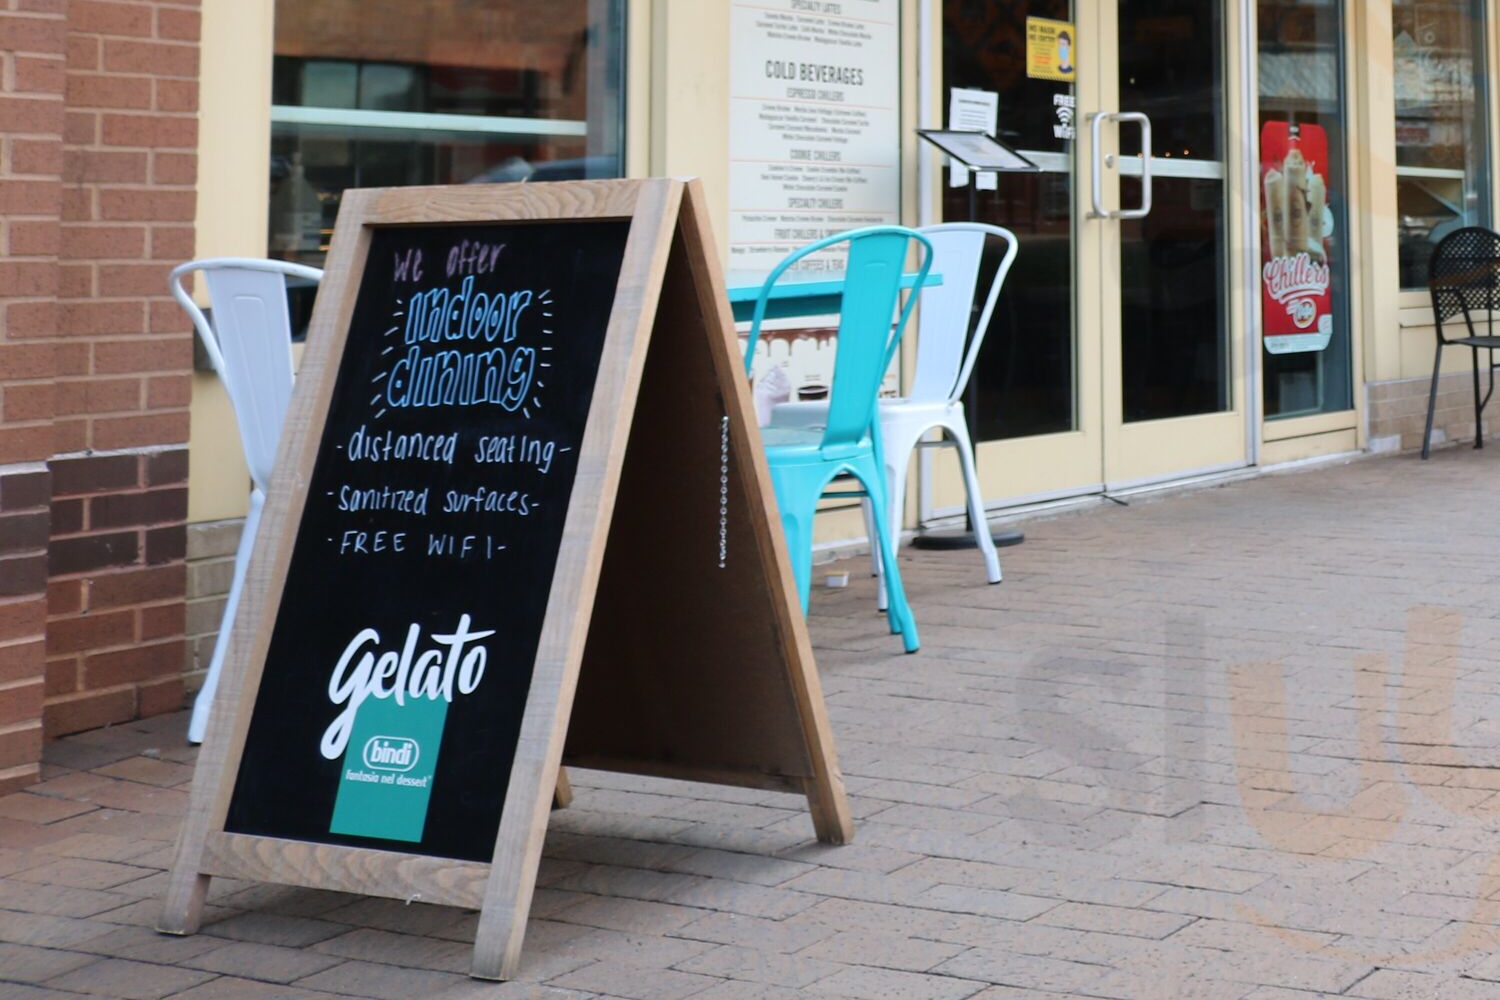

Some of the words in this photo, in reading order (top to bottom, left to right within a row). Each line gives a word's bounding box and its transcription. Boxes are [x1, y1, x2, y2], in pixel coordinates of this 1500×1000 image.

[765, 59, 796, 80] COLD
[799, 63, 864, 86] BEVERAGES
[446, 240, 507, 278] offer
[1262, 252, 1331, 299] Chillers
[387, 345, 536, 412] dining
[370, 740, 413, 766] bindi
